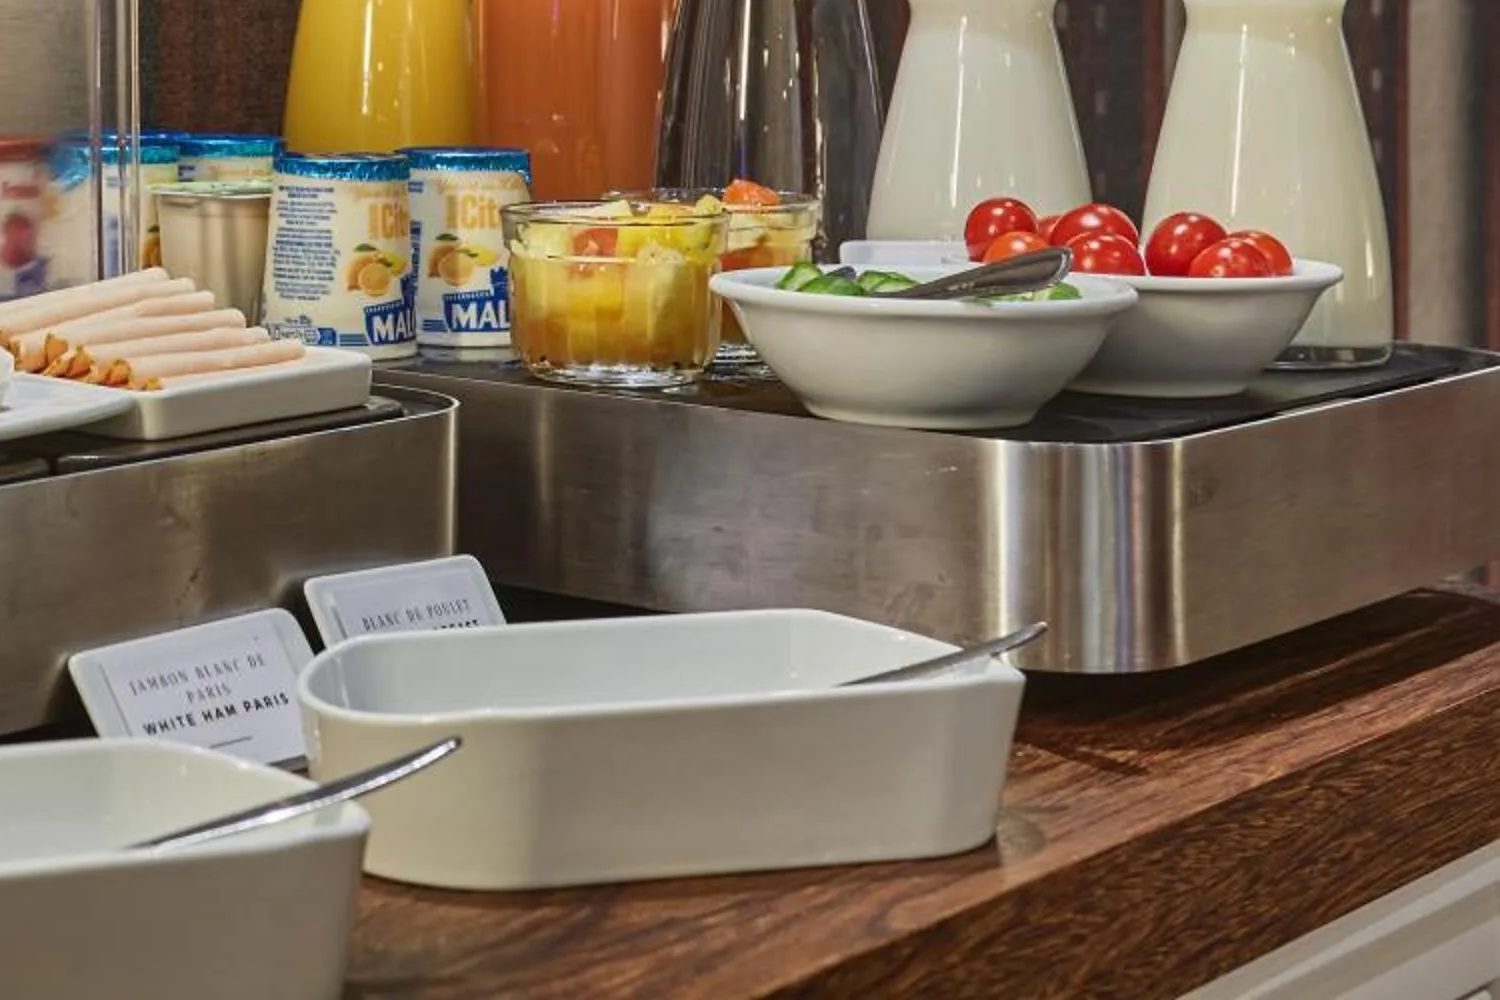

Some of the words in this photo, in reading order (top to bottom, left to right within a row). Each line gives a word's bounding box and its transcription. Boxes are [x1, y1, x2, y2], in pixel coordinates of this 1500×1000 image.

[361, 611, 400, 631] BLANC
[405, 606, 422, 623] DE
[128, 669, 189, 697] JAMBON
[194, 657, 241, 680] BLANC
[247, 652, 266, 669] DE
[185, 682, 233, 704] PARIS
[142, 713, 197, 736] WHITE
[201, 703, 238, 723] HAM
[243, 692, 290, 713] PARIS
